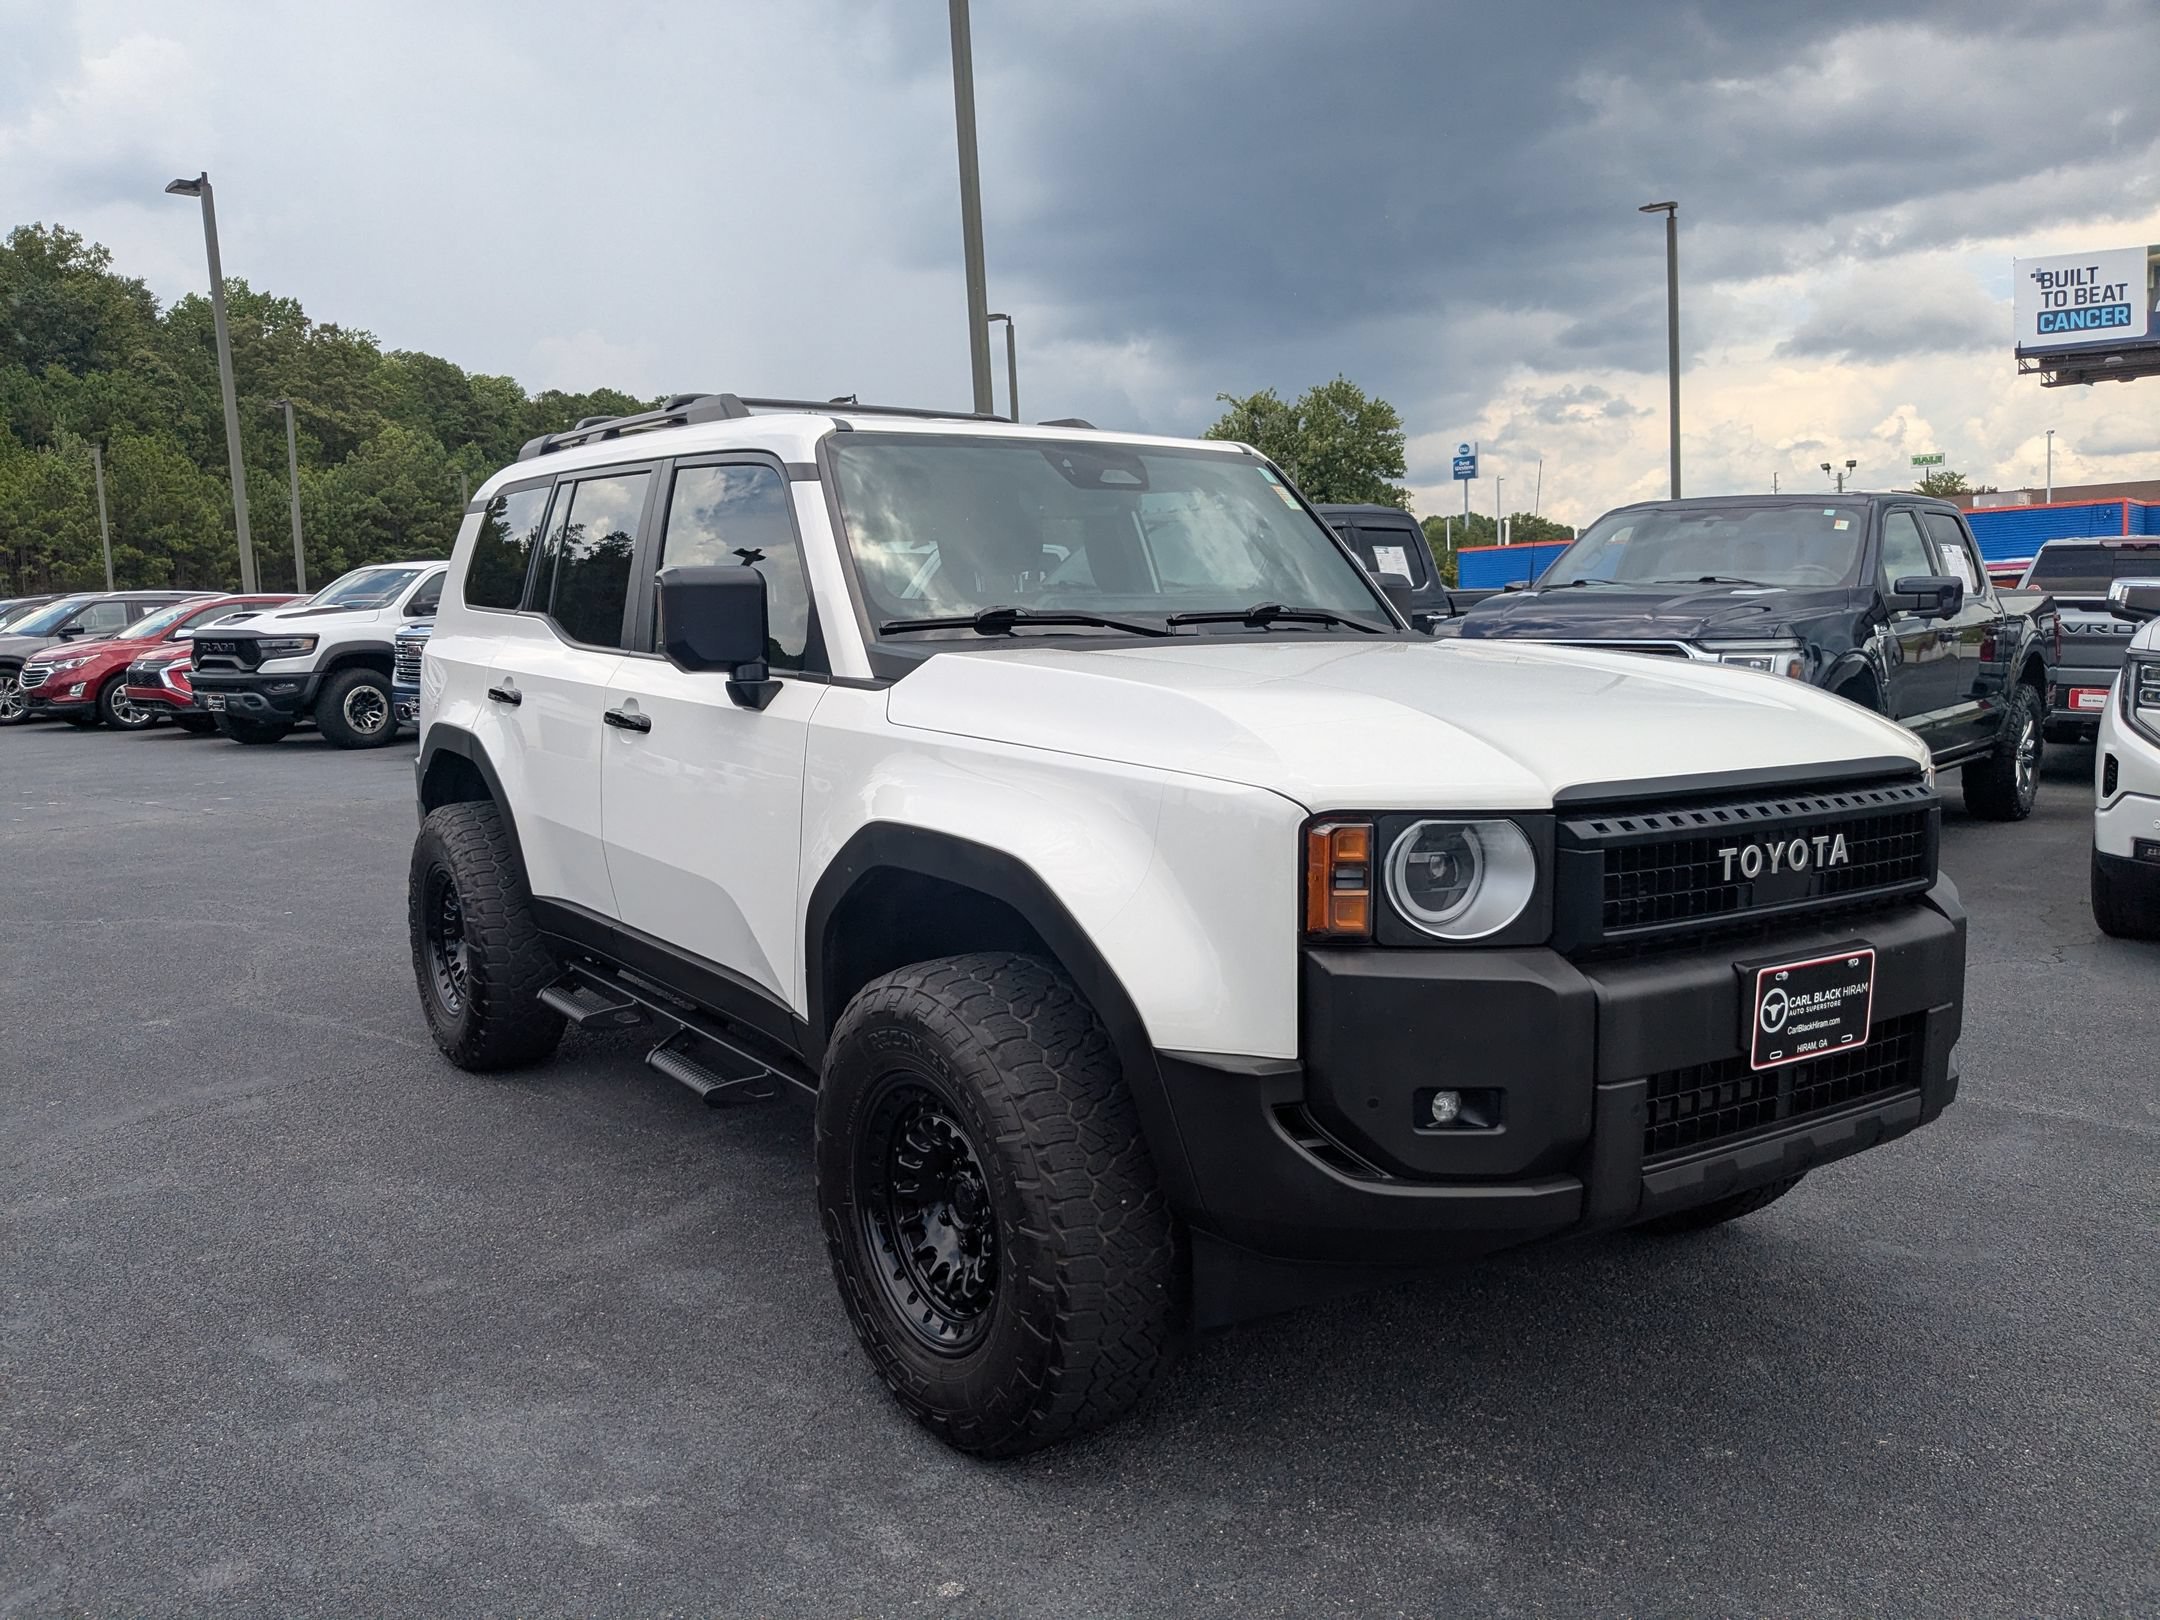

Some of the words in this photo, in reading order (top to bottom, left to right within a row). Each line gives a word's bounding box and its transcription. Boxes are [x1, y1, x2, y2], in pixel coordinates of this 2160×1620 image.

[2041, 266, 2098, 289] BUILT
[2041, 290, 2068, 308] TO
[2074, 283, 2128, 305] BEAT
[2039, 306, 2129, 331] CANCER
[200, 642, 236, 652] RAM
[1718, 833, 1849, 881] TOYOTA
[1789, 994, 1812, 1008] CARL
[1814, 988, 1842, 1002] BLACK
[1842, 982, 1868, 997] HIRAM
[1788, 1008, 1804, 1017] AUTO
[1805, 999, 1841, 1013] SUPERSTORE
[1787, 1017, 1841, 1035] CarlBlackHiram.com
[1818, 1039, 1828, 1048] GA
